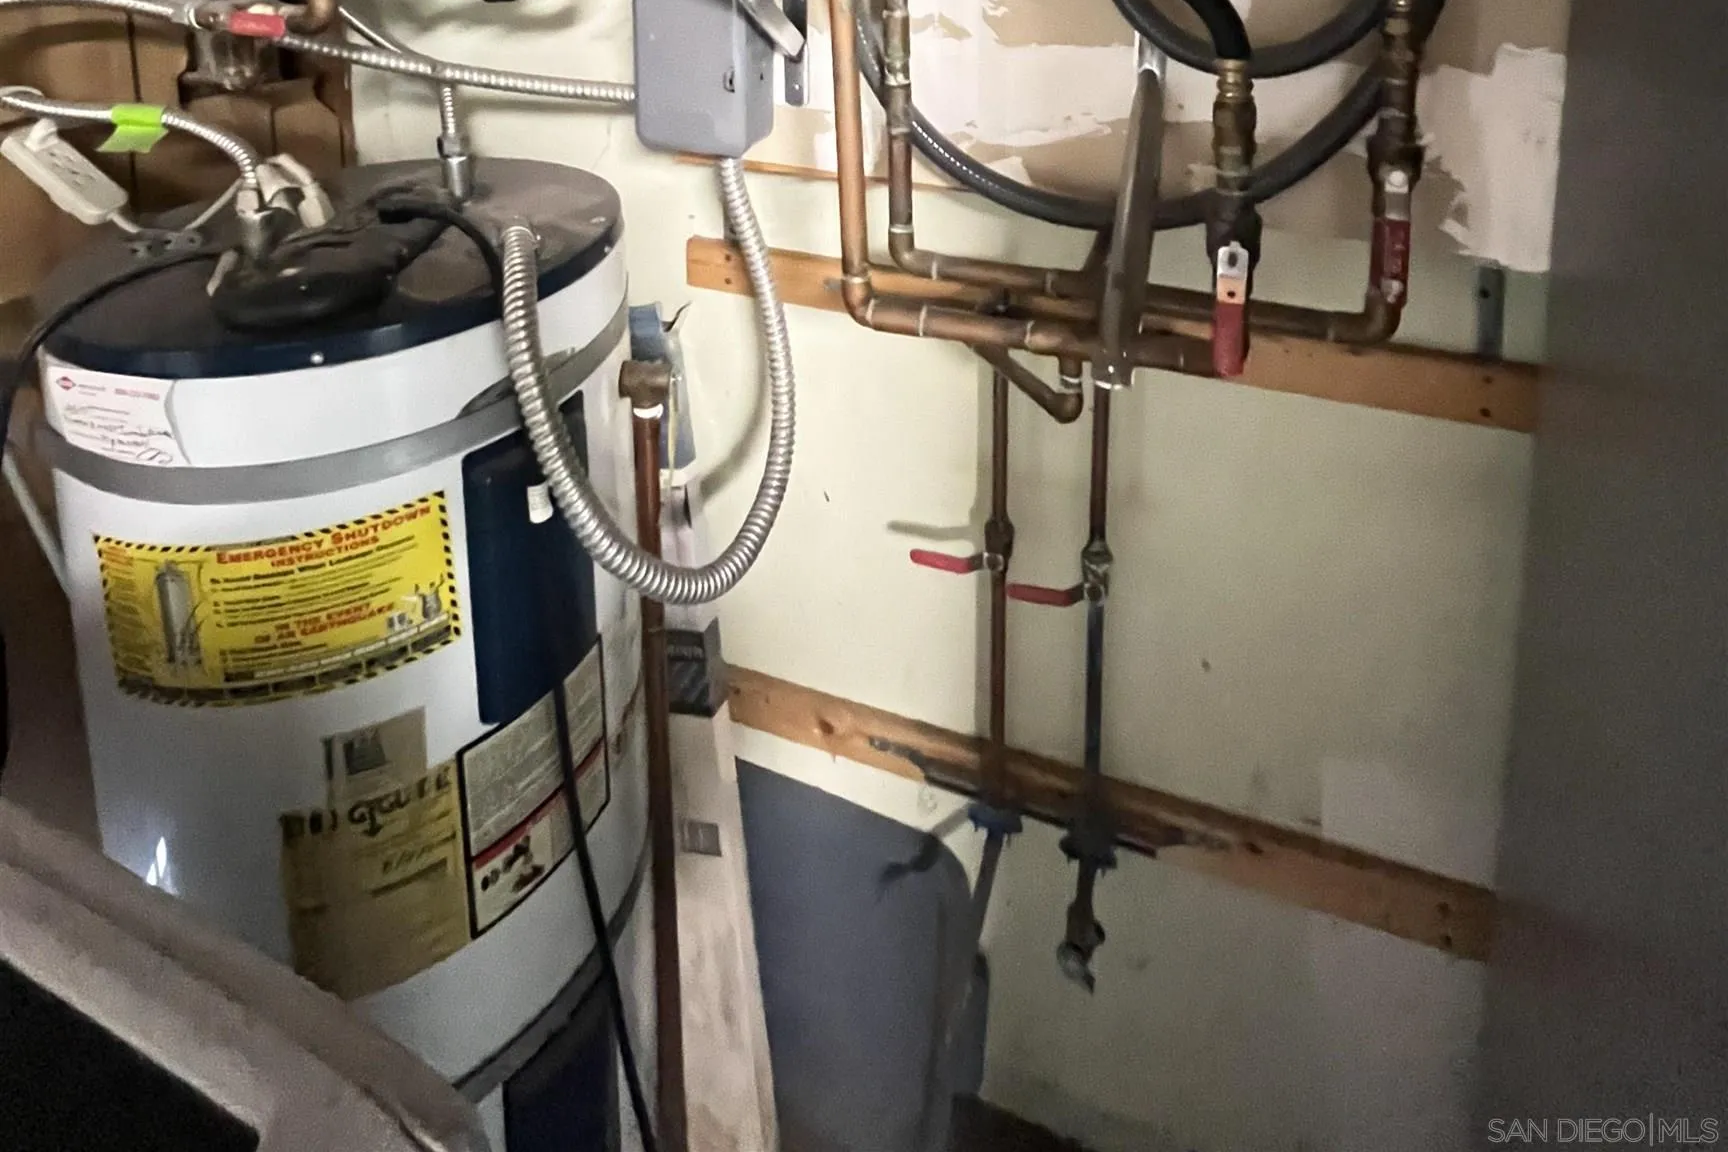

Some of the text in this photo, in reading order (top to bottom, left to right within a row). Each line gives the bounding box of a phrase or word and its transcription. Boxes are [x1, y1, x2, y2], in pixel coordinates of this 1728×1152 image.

[216, 539, 324, 565] EMERGENCY
[330, 506, 431, 545] SHUTDOWN
[271, 535, 380, 568] INSTRUCTIONS
